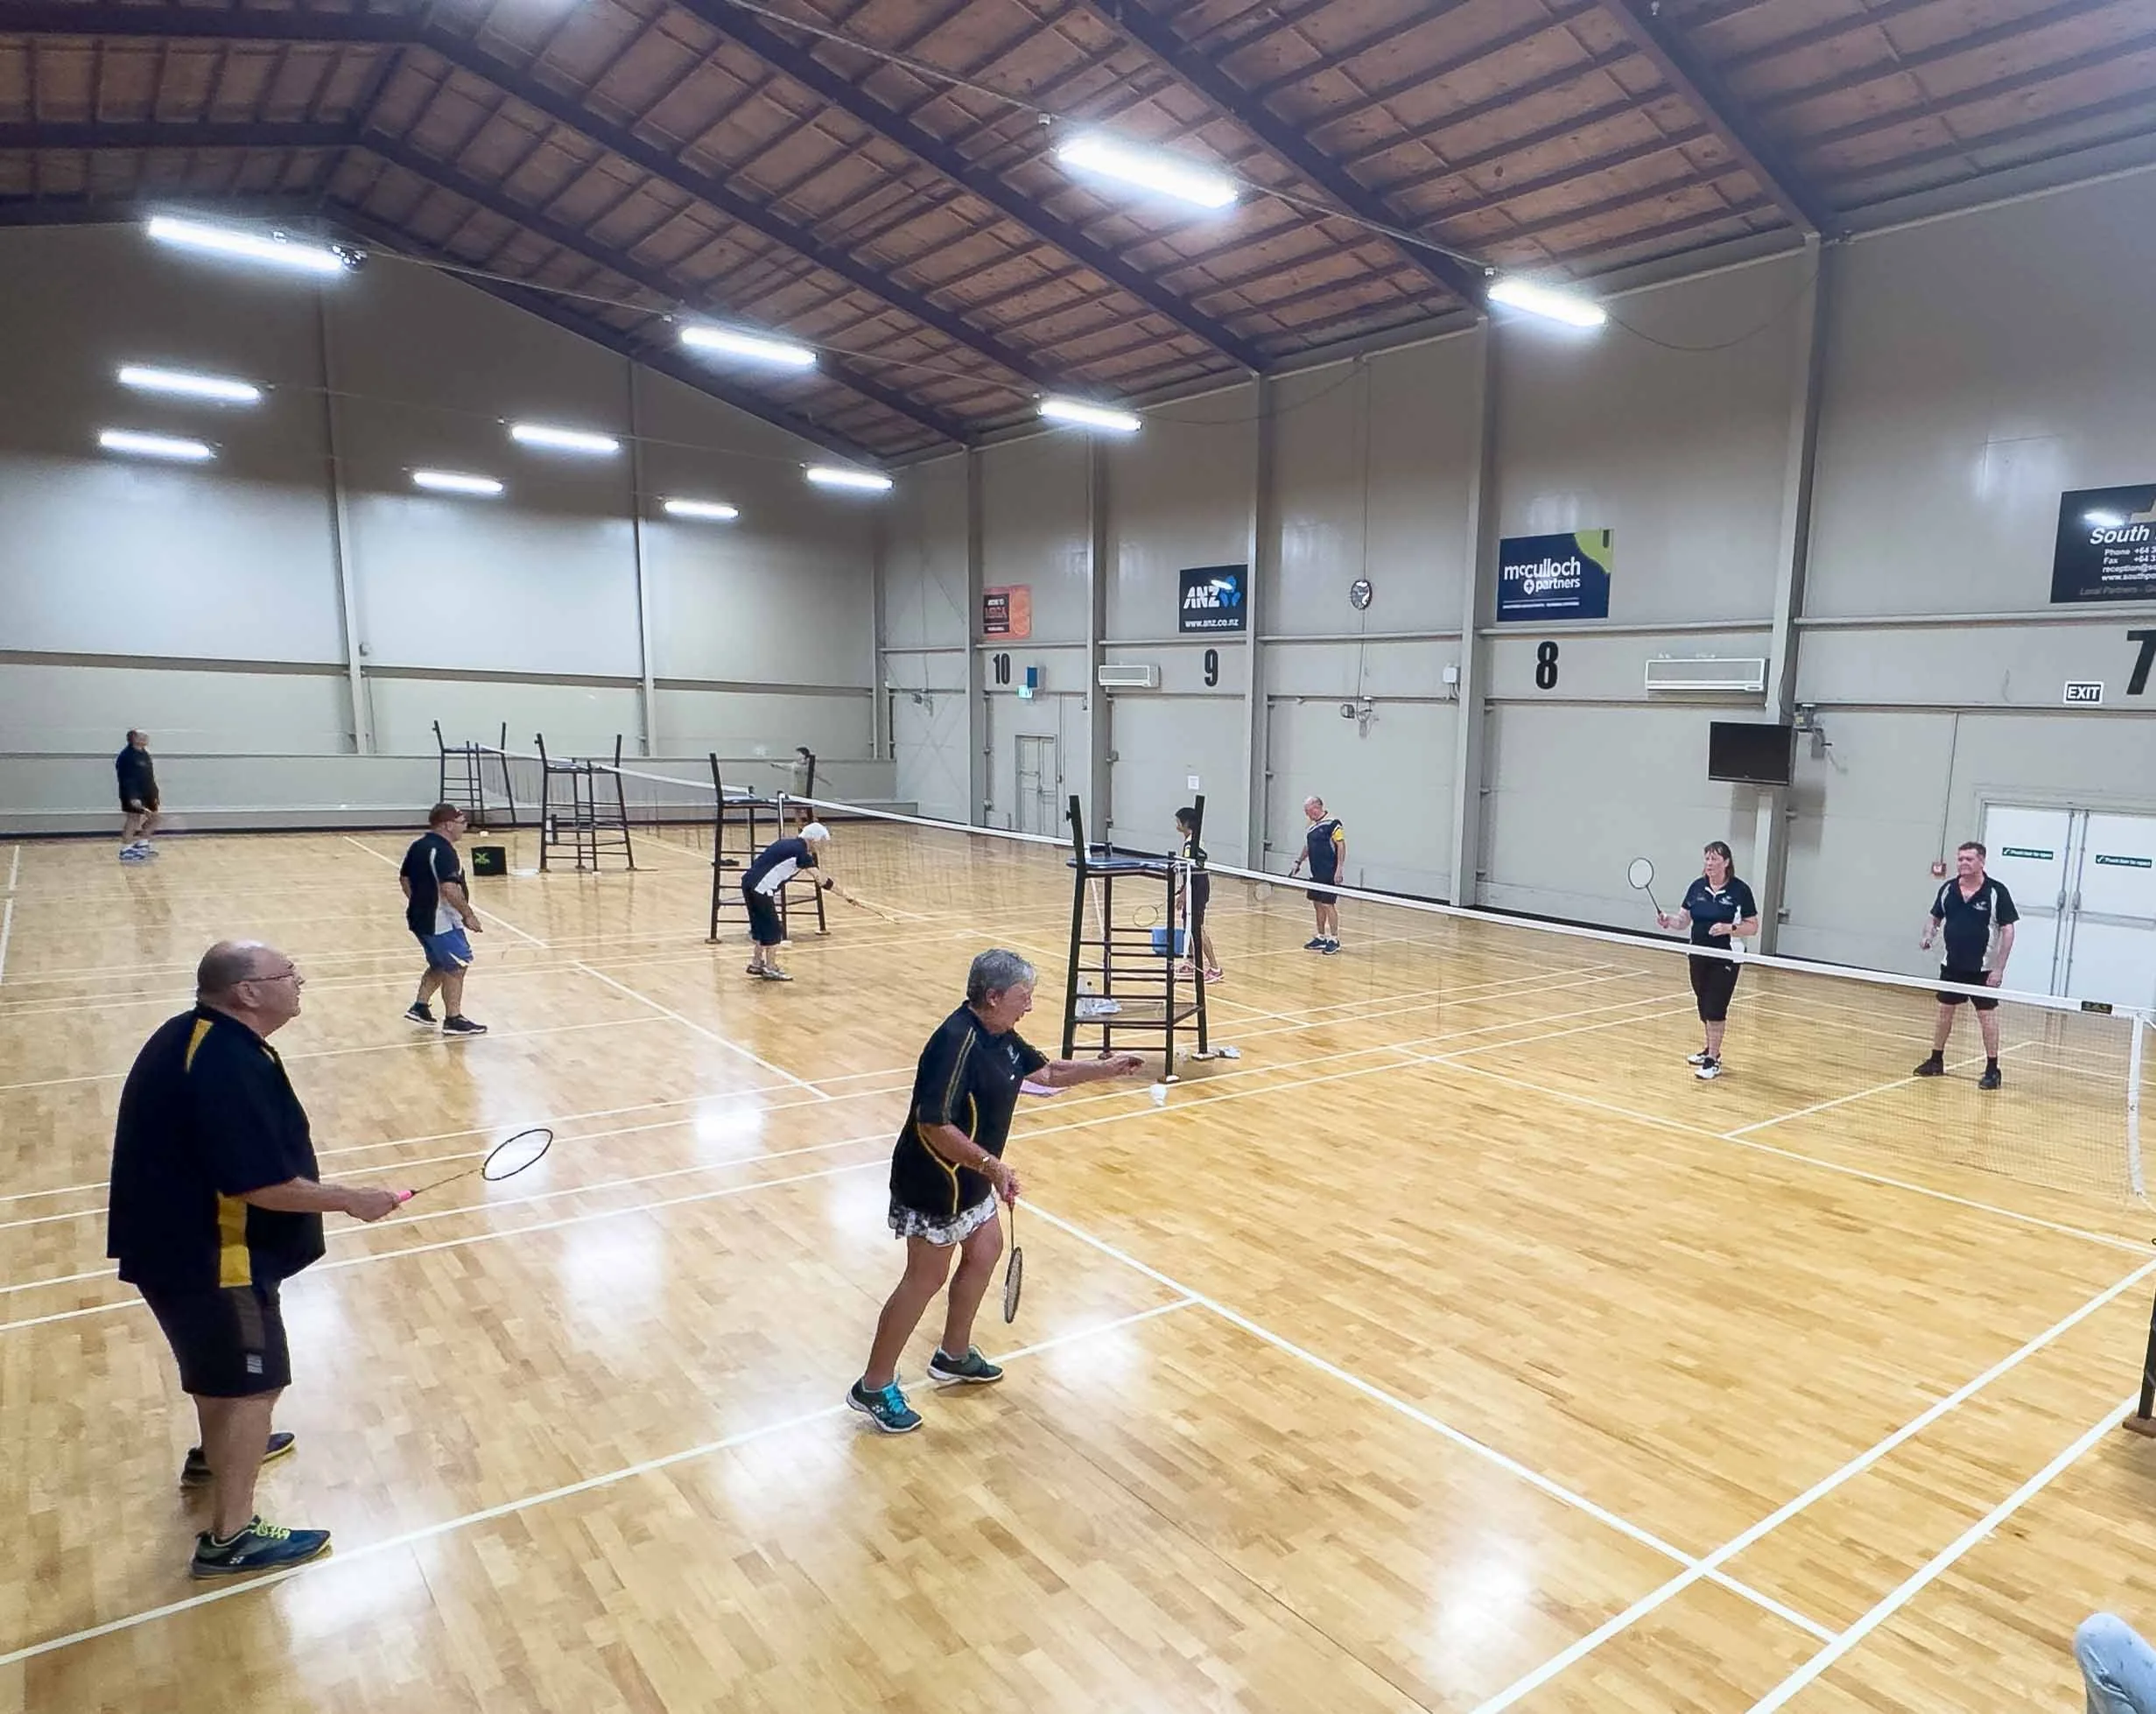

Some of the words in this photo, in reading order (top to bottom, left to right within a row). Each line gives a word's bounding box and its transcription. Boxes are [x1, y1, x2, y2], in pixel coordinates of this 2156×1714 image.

[2089, 525, 2150, 544] South
[1183, 585, 1220, 609] ANZ
[1535, 578, 1580, 592] partners
[1184, 618, 1240, 628] www.anz.co.nz
[993, 653, 1010, 685] 10
[1204, 649, 1218, 686] 9
[1535, 641, 1558, 690] 8
[2126, 629, 2156, 695] 7
[2068, 685, 2100, 699] EXIT
